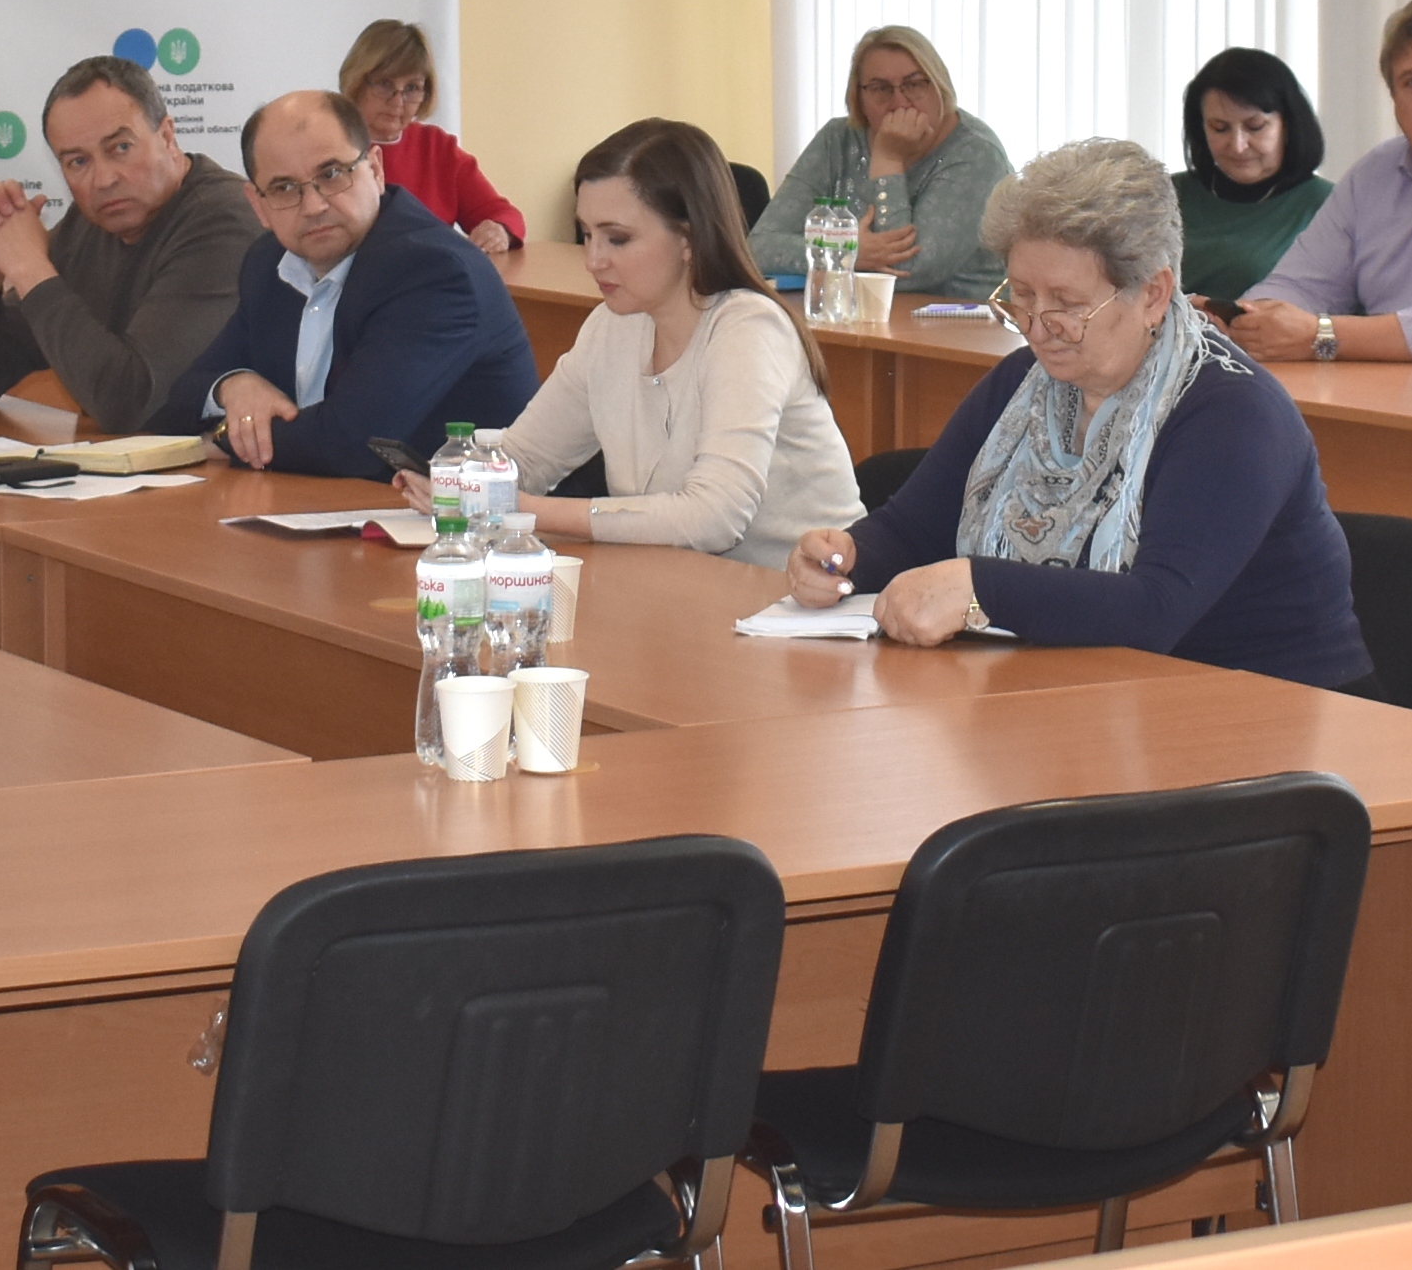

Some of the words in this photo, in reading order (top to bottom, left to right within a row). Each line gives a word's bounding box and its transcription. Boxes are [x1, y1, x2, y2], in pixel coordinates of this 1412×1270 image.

[175, 82, 235, 92] податкова
[207, 125, 241, 133] області
[46, 198, 63, 207] STS
[489, 571, 553, 589] моршинсь
